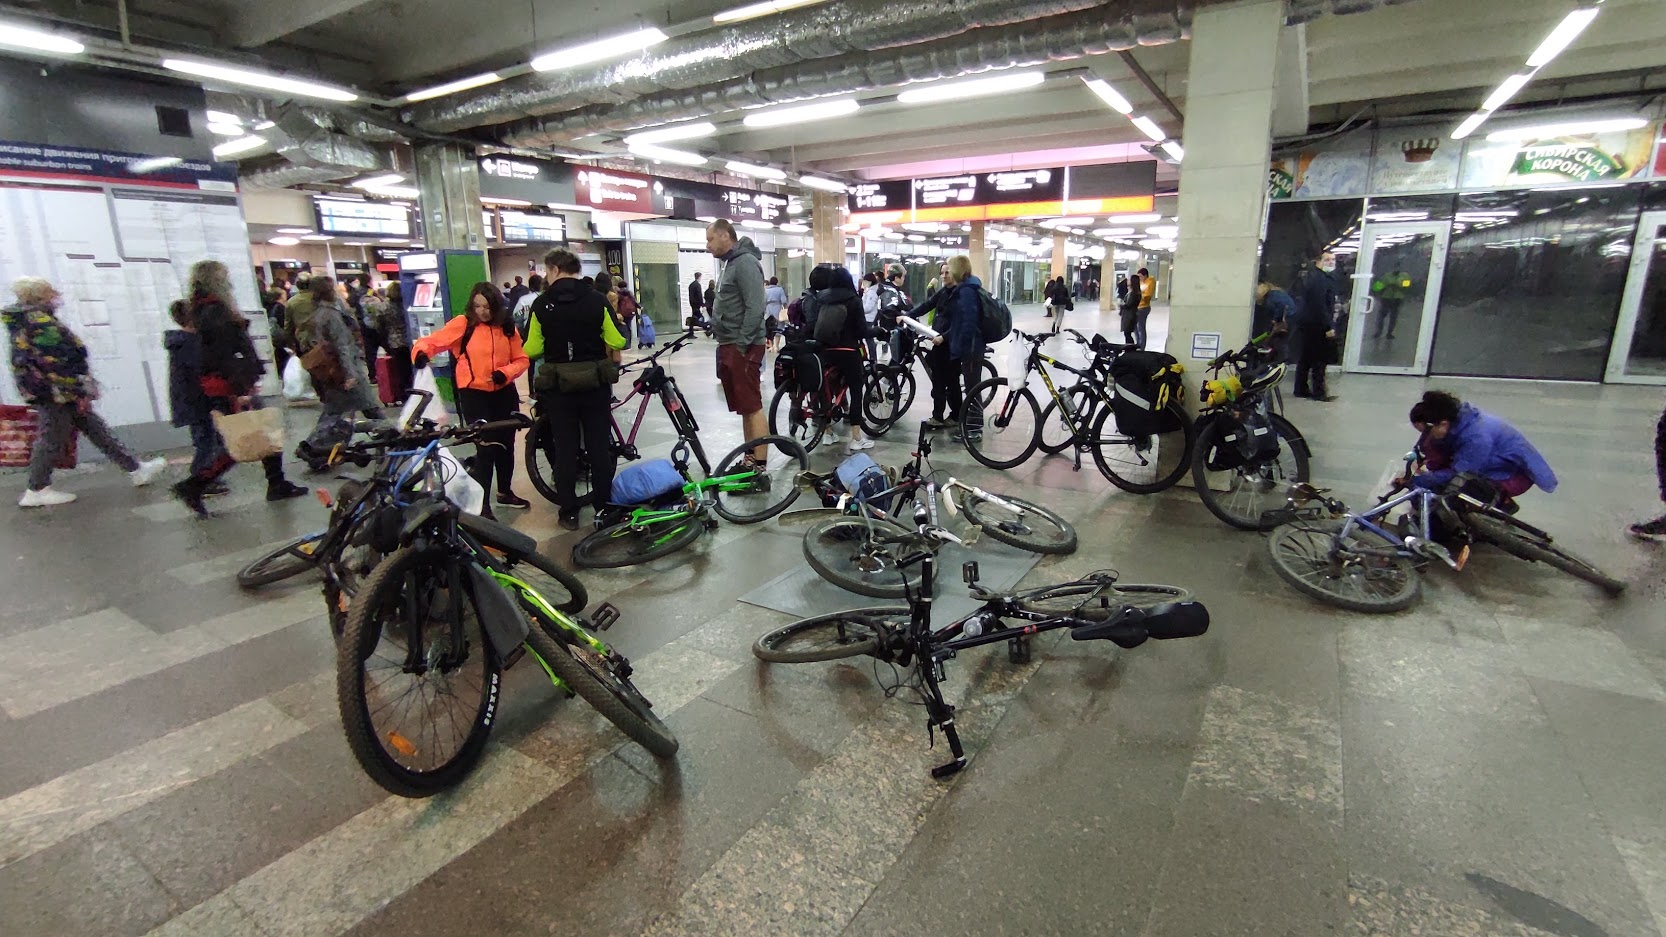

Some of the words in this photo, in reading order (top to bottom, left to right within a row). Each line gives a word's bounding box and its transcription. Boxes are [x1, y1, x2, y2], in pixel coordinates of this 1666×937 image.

[44, 149, 99, 160] движения
[1525, 147, 1611, 176] СИБИРСКАЯ
[23, 158, 67, 169] suburban
[67, 162, 92, 171] trains
[1531, 159, 1591, 181] КОРОНА
[608, 250, 621, 266] 100
[483, 672, 499, 726] MAXXIS
